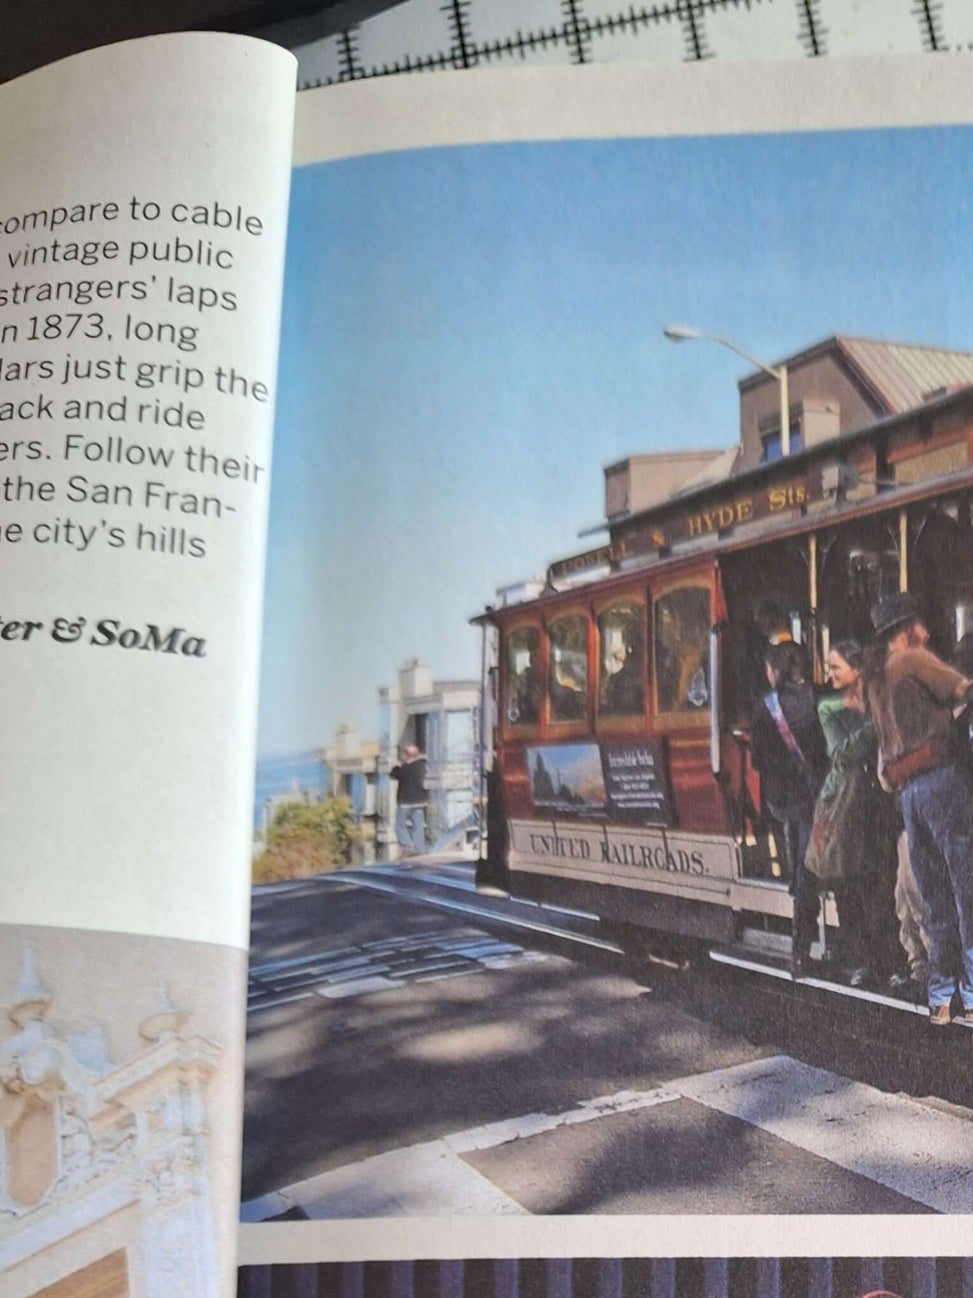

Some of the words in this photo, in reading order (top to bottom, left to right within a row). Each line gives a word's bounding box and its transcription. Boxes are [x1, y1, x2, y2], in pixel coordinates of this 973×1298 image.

[129, 195, 161, 221] to
[171, 201, 263, 236] cable
[8, 239, 119, 268] vintage
[129, 236, 233, 269] public
[168, 276, 237, 313] laps
[27, 313, 112, 341] 1873,
[125, 314, 199, 352] long
[61, 353, 127, 385] just
[135, 360, 204, 393] grip
[214, 366, 270, 403] the
[0, 394, 53, 421] ack
[63, 395, 127, 422] and
[138, 399, 205, 430] ride
[64, 434, 175, 468] Follow
[184, 445, 263, 482] their
[2, 475, 56, 501] the
[66, 475, 132, 506] San
[145, 480, 236, 518] Fran-
[33, 517, 125, 552] city's
[136, 523, 206, 558] hills
[686, 499, 753, 536] HYDE
[51, 616, 88, 644] &
[90, 618, 208, 658] SoMa
[530, 834, 590, 860] UNITED
